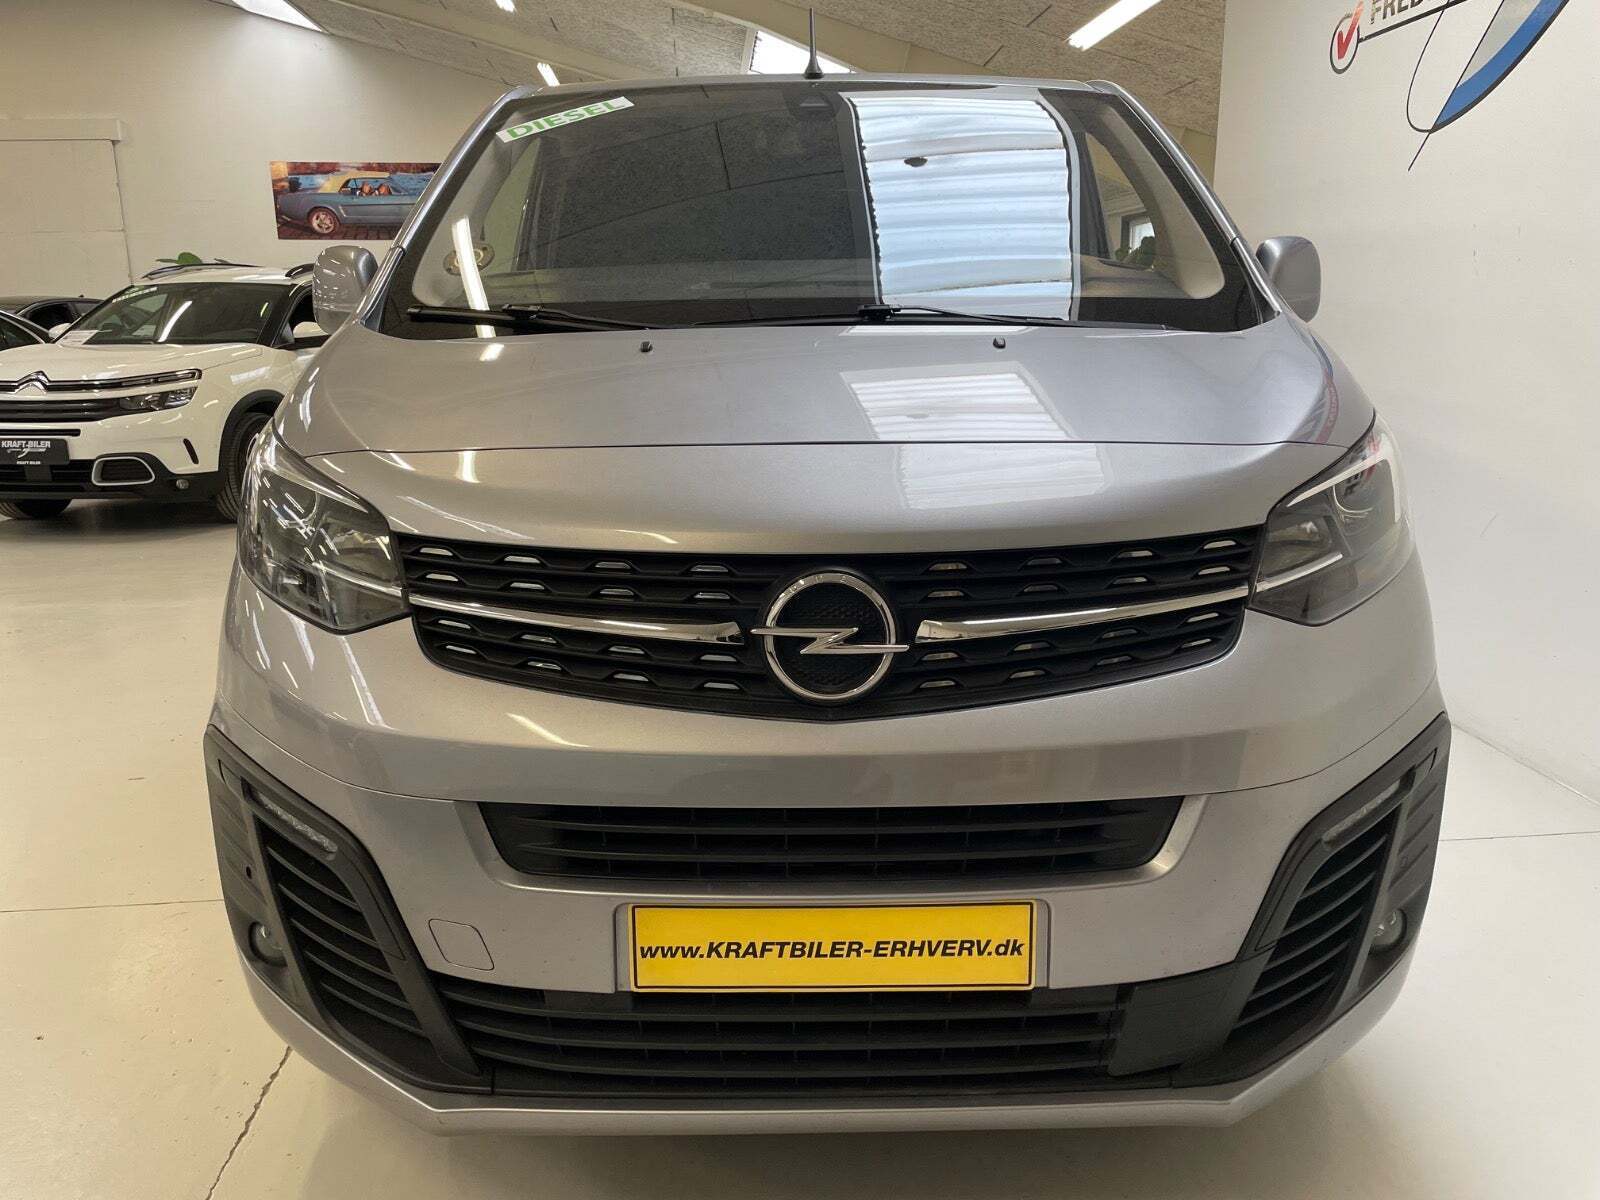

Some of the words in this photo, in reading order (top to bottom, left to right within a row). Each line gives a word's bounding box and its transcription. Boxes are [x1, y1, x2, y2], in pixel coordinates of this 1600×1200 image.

[1371, 0, 1424, 24] FR
[507, 101, 626, 138] DIESEL
[640, 939, 1025, 959] www.KRAFTBILER-ERHVERV.dk
